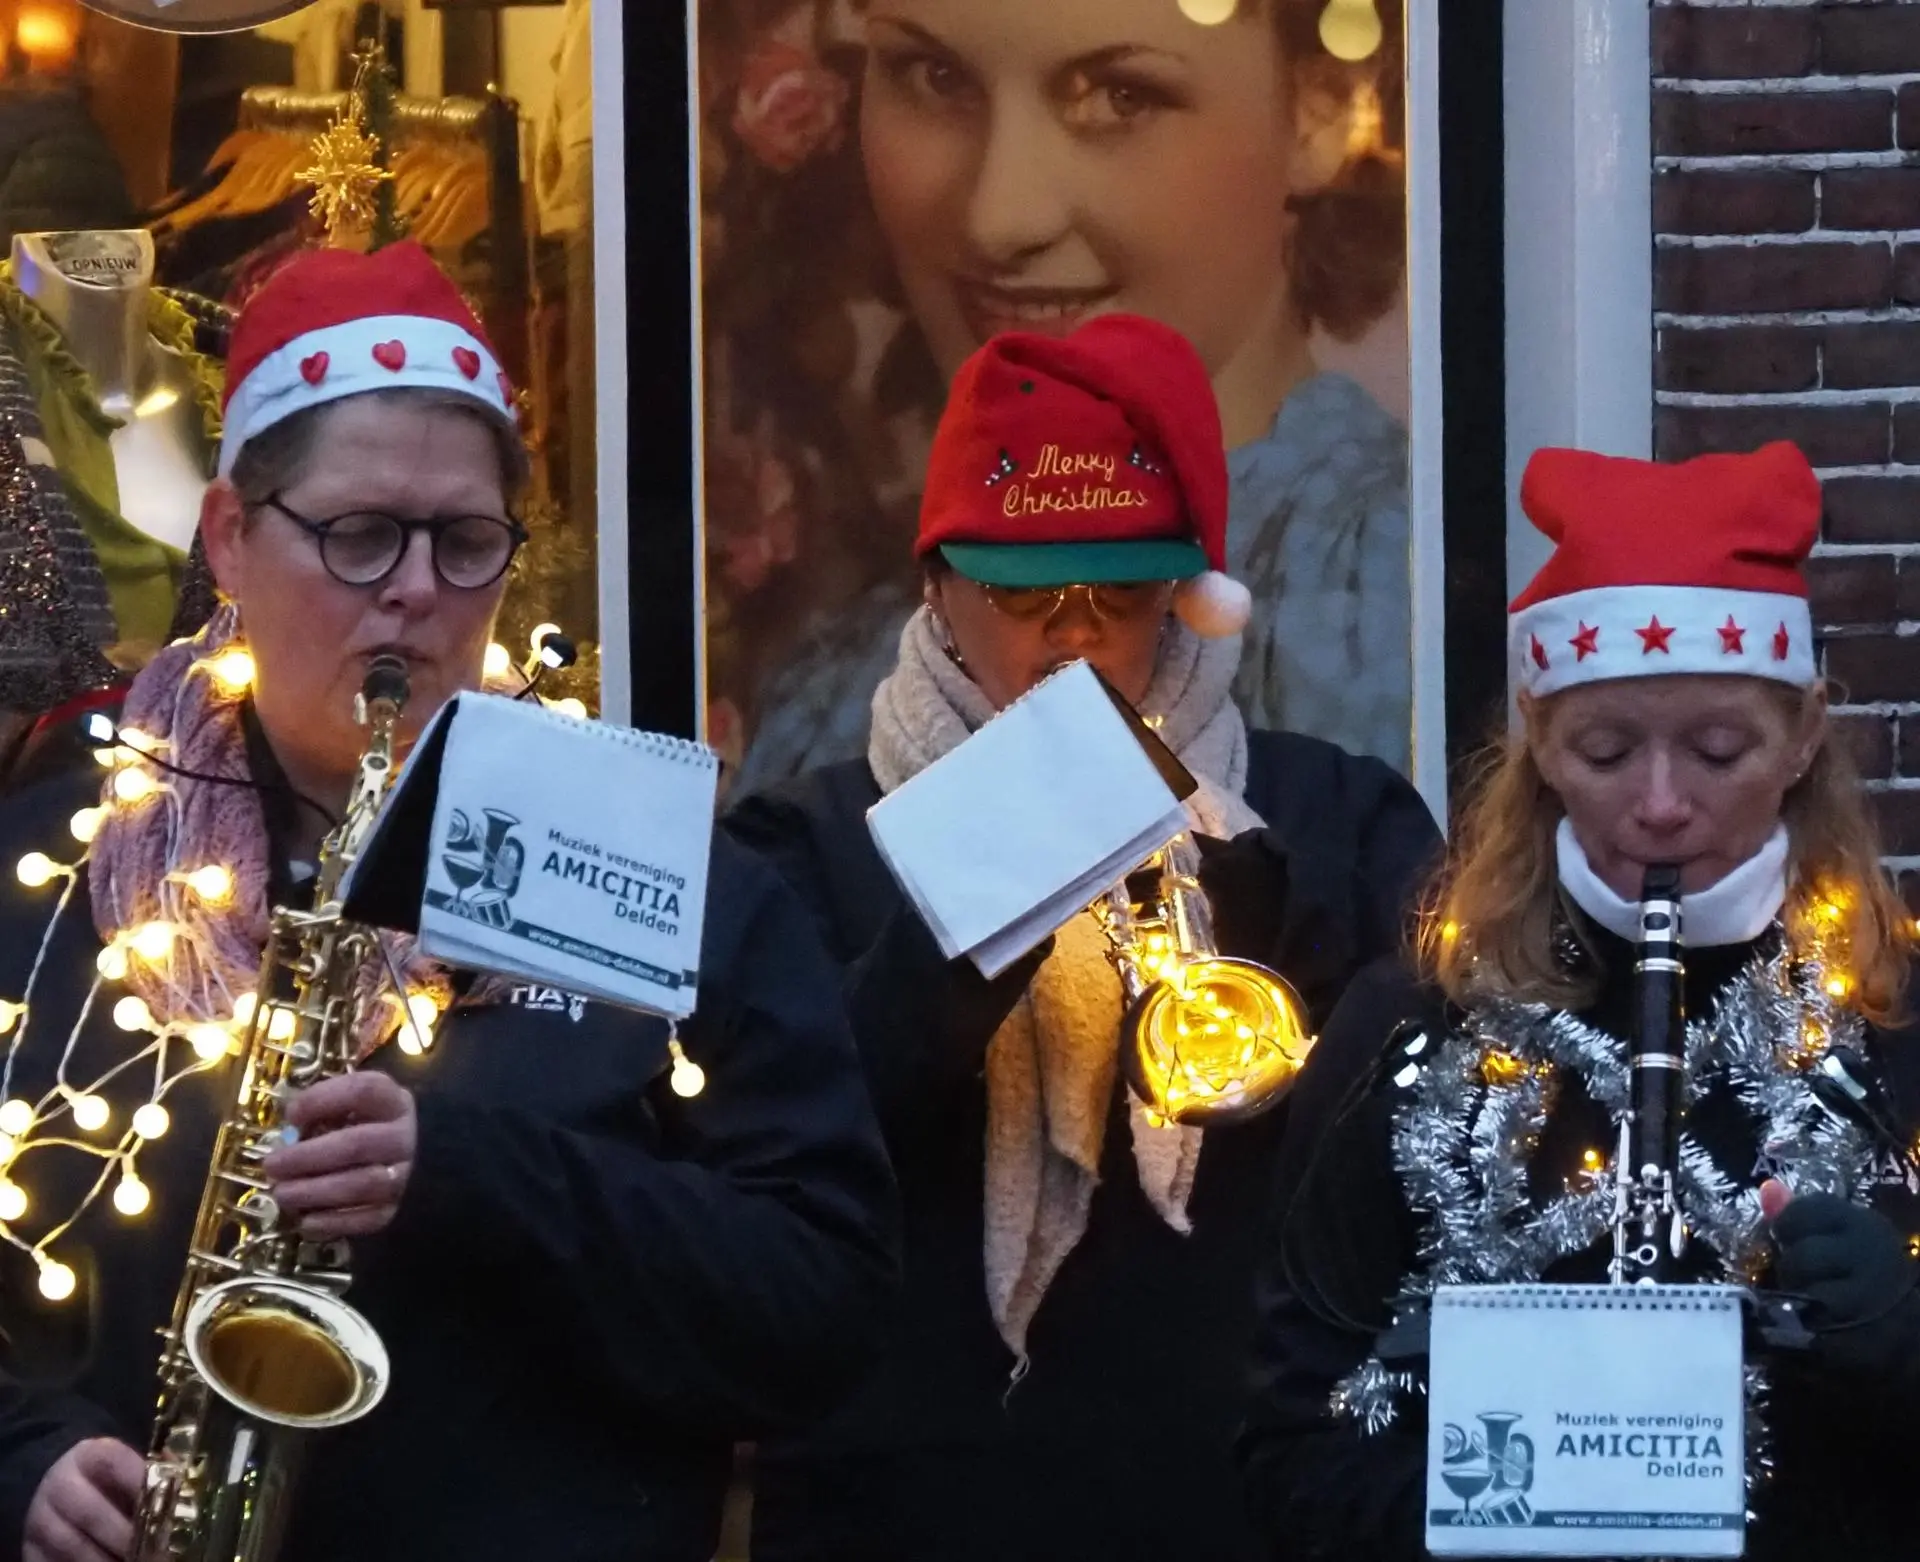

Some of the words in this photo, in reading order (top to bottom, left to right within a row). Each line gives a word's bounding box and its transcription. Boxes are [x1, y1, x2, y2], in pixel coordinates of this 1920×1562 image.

[72, 258, 137, 271] OPNIEUW
[1027, 444, 1115, 481] Merry
[1003, 482, 1148, 517] Christmas
[548, 829, 601, 856] Muziek
[606, 848, 686, 890] vereniging
[542, 851, 681, 918] AMICITIA
[614, 902, 679, 936] Delden
[1556, 1413, 1619, 1426] Muziek
[1626, 1413, 1723, 1429] vereniging
[1555, 1434, 1723, 1458] AMICITIA
[1647, 1461, 1724, 1478] Delden
